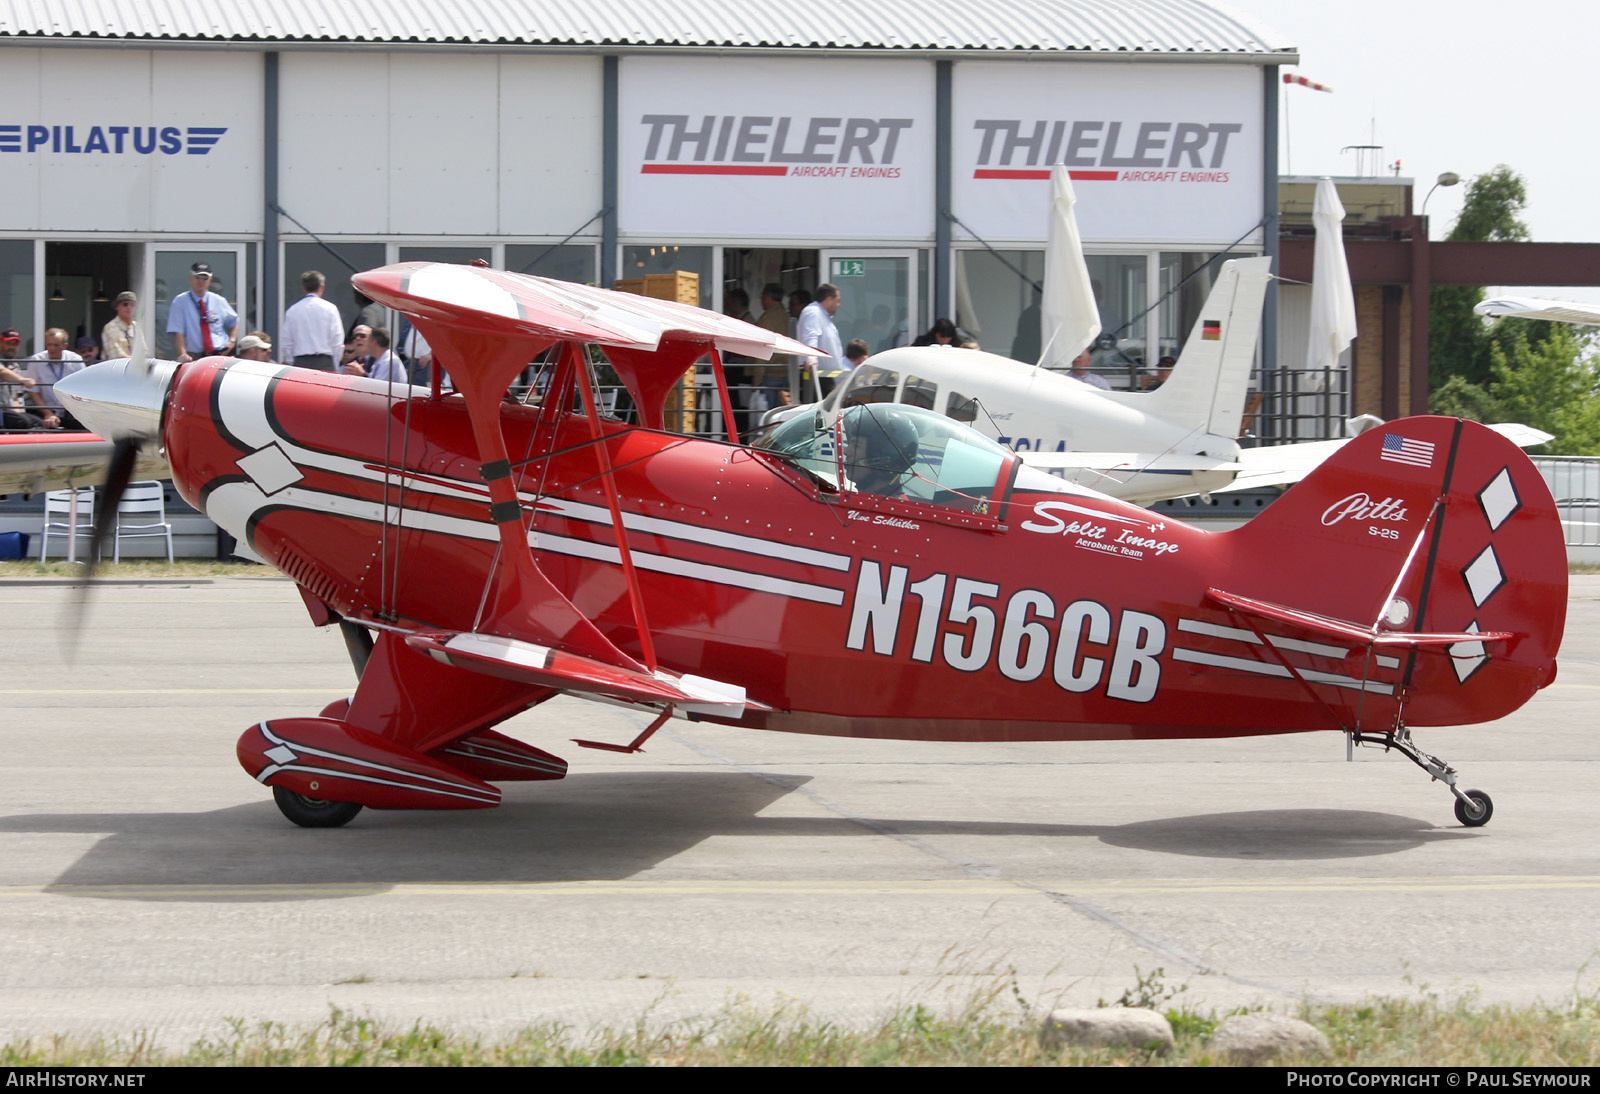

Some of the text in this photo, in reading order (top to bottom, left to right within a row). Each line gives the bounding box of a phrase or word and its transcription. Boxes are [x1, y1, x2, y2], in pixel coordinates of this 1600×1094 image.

[27, 125, 182, 155] PILATUS
[641, 114, 914, 164] THIELERT
[973, 119, 1243, 168] THIELERT
[791, 166, 901, 179] AIRCRAFT ENGINES
[1121, 171, 1230, 183] AIRCRAFT ENGINES
[847, 510, 870, 522] Uwe
[1321, 492, 1408, 526] Pitts
[1020, 501, 1179, 556] Split Image
[1368, 526, 1399, 540] S-2S
[1075, 537, 1143, 557] Aerobatic Team
[845, 558, 1167, 704] N156CB
